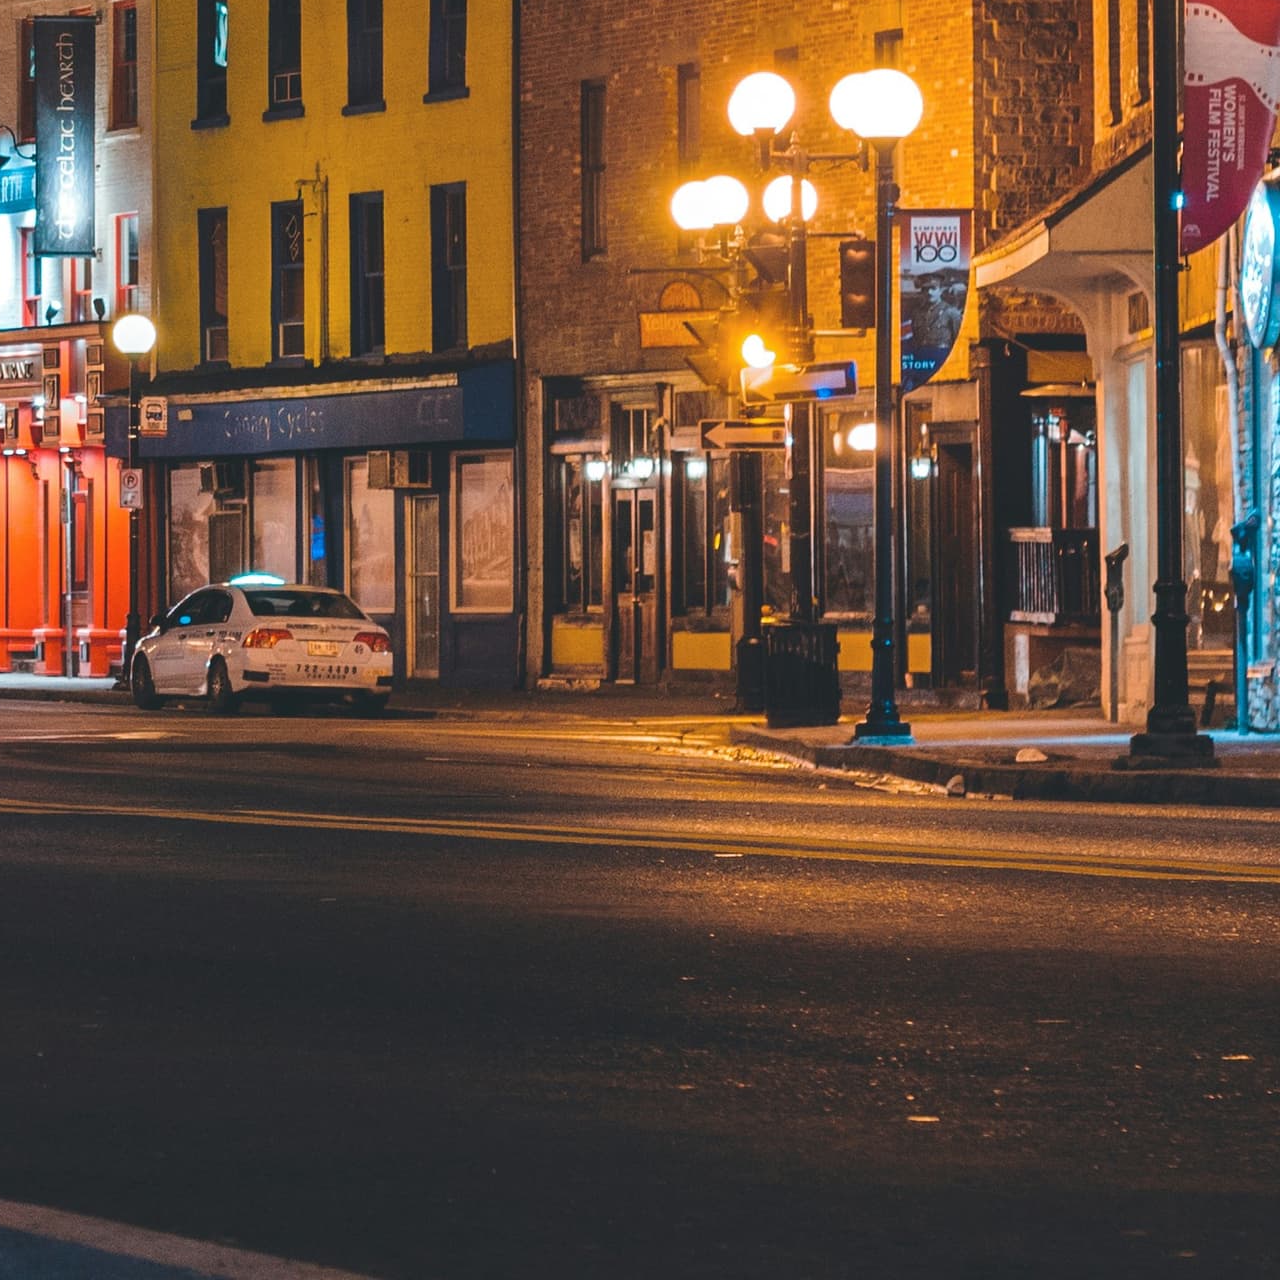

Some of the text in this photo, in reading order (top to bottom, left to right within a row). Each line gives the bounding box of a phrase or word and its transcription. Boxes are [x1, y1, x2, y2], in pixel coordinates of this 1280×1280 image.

[1206, 88, 1222, 203] FILM FESTIVAL
[1222, 84, 1237, 163] WOMEN'S
[914, 232, 957, 248] WWI
[914, 245, 957, 263] 100
